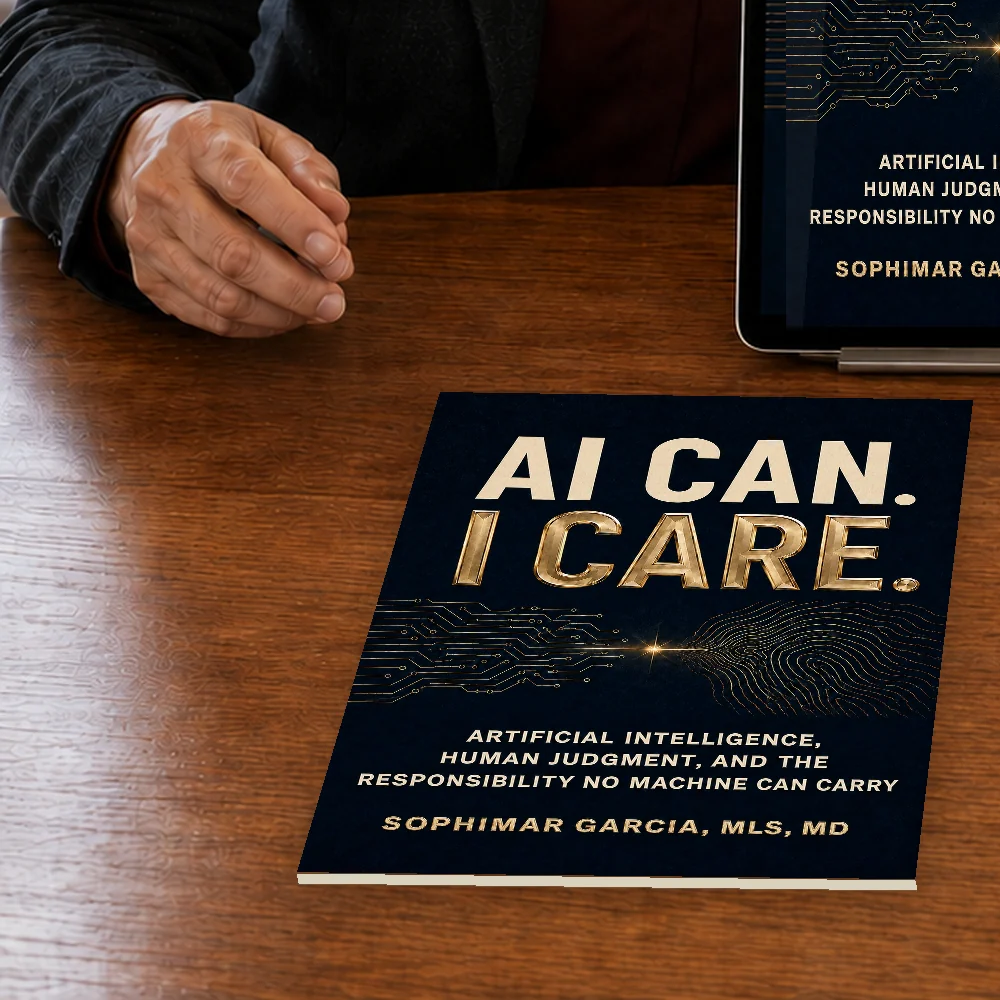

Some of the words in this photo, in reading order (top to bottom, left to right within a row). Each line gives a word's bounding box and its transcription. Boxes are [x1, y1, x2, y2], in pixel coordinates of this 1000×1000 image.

[879, 154, 984, 169] ARTIFICIAL
[865, 182, 934, 196] HUMAN
[810, 209, 962, 224] RESPONSIBILITY
[970, 209, 995, 224] NO
[836, 261, 962, 277] SOPHIMAR
[475, 436, 605, 500] AI
[645, 438, 916, 505] CAN.
[452, 510, 500, 585] I
[534, 511, 920, 592] CARE.
[466, 730, 613, 743] ARTIFICIAL
[625, 732, 820, 748] INTELLIGENCE,
[440, 752, 539, 764] HUMAN
[549, 753, 701, 769] JUDGMENT,
[711, 755, 767, 767] AND
[779, 756, 828, 768] THE
[358, 773, 575, 788] RESPONSIBILITY
[583, 776, 619, 788] NO
[630, 777, 748, 790] MACHINE
[757, 778, 807, 790] CAN
[817, 779, 898, 791] CARRY
[382, 816, 563, 832] SOPHIMAR
[576, 819, 708, 836] GARCIA,
[721, 820, 791, 837] MLS,
[803, 821, 848, 835] MD
